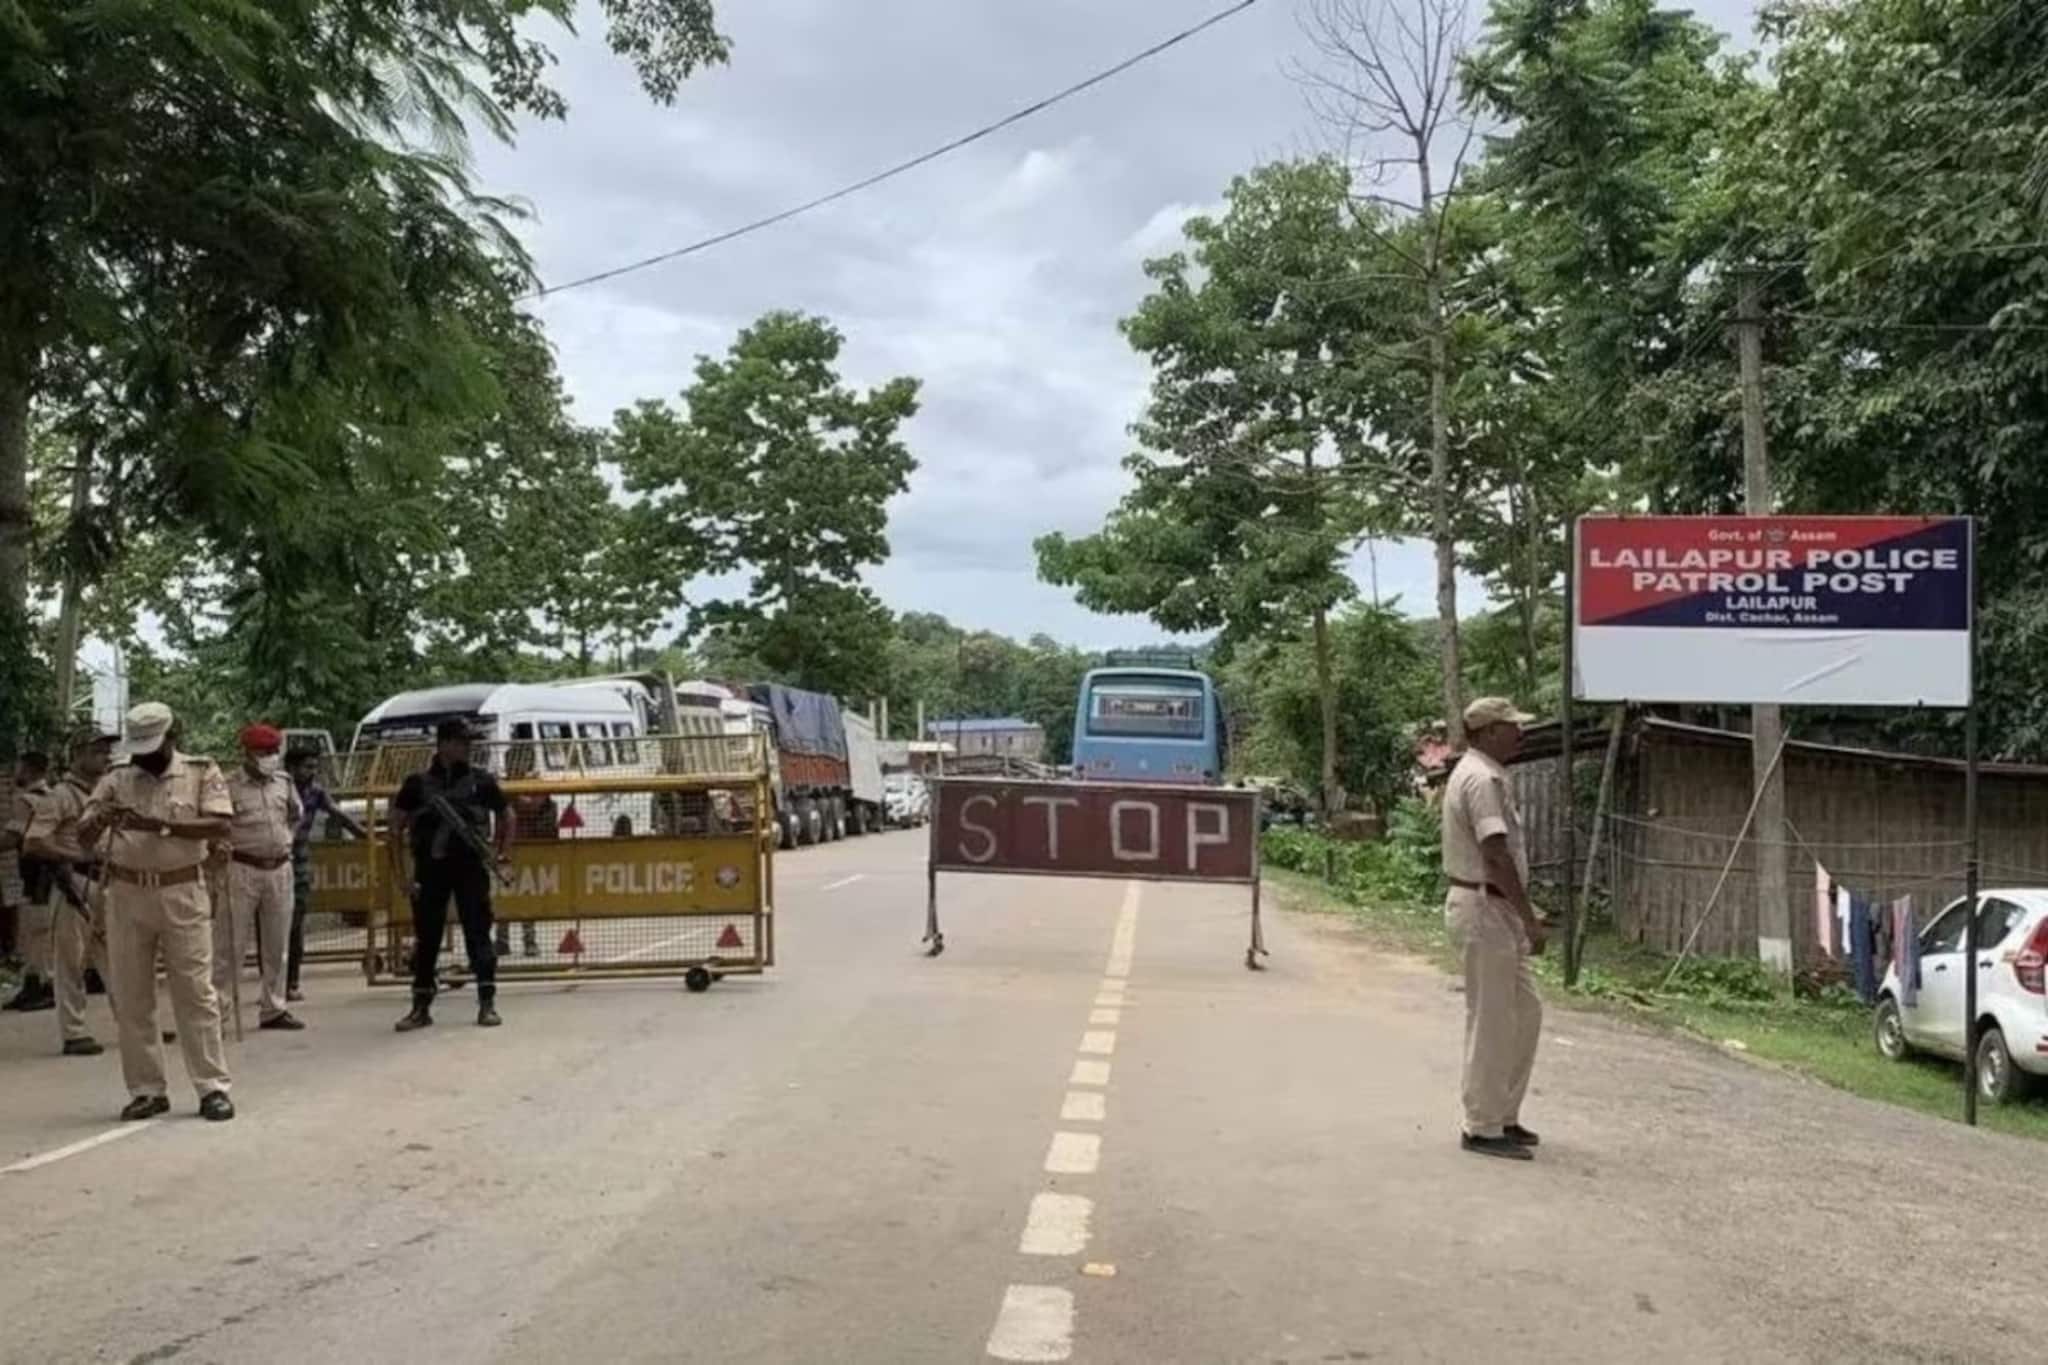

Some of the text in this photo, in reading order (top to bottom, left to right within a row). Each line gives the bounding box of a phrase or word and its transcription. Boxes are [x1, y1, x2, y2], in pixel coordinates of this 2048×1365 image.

[1708, 529, 1838, 541] Govt. of Assam
[1590, 548, 1959, 571] LAILAPUR POLICE
[1632, 571, 1914, 594] PATROL POST
[1725, 595, 1817, 610] LAILAPUR
[1793, 612, 1840, 623] Assam
[958, 794, 1230, 871] STOP
[586, 861, 695, 896] POLICE
